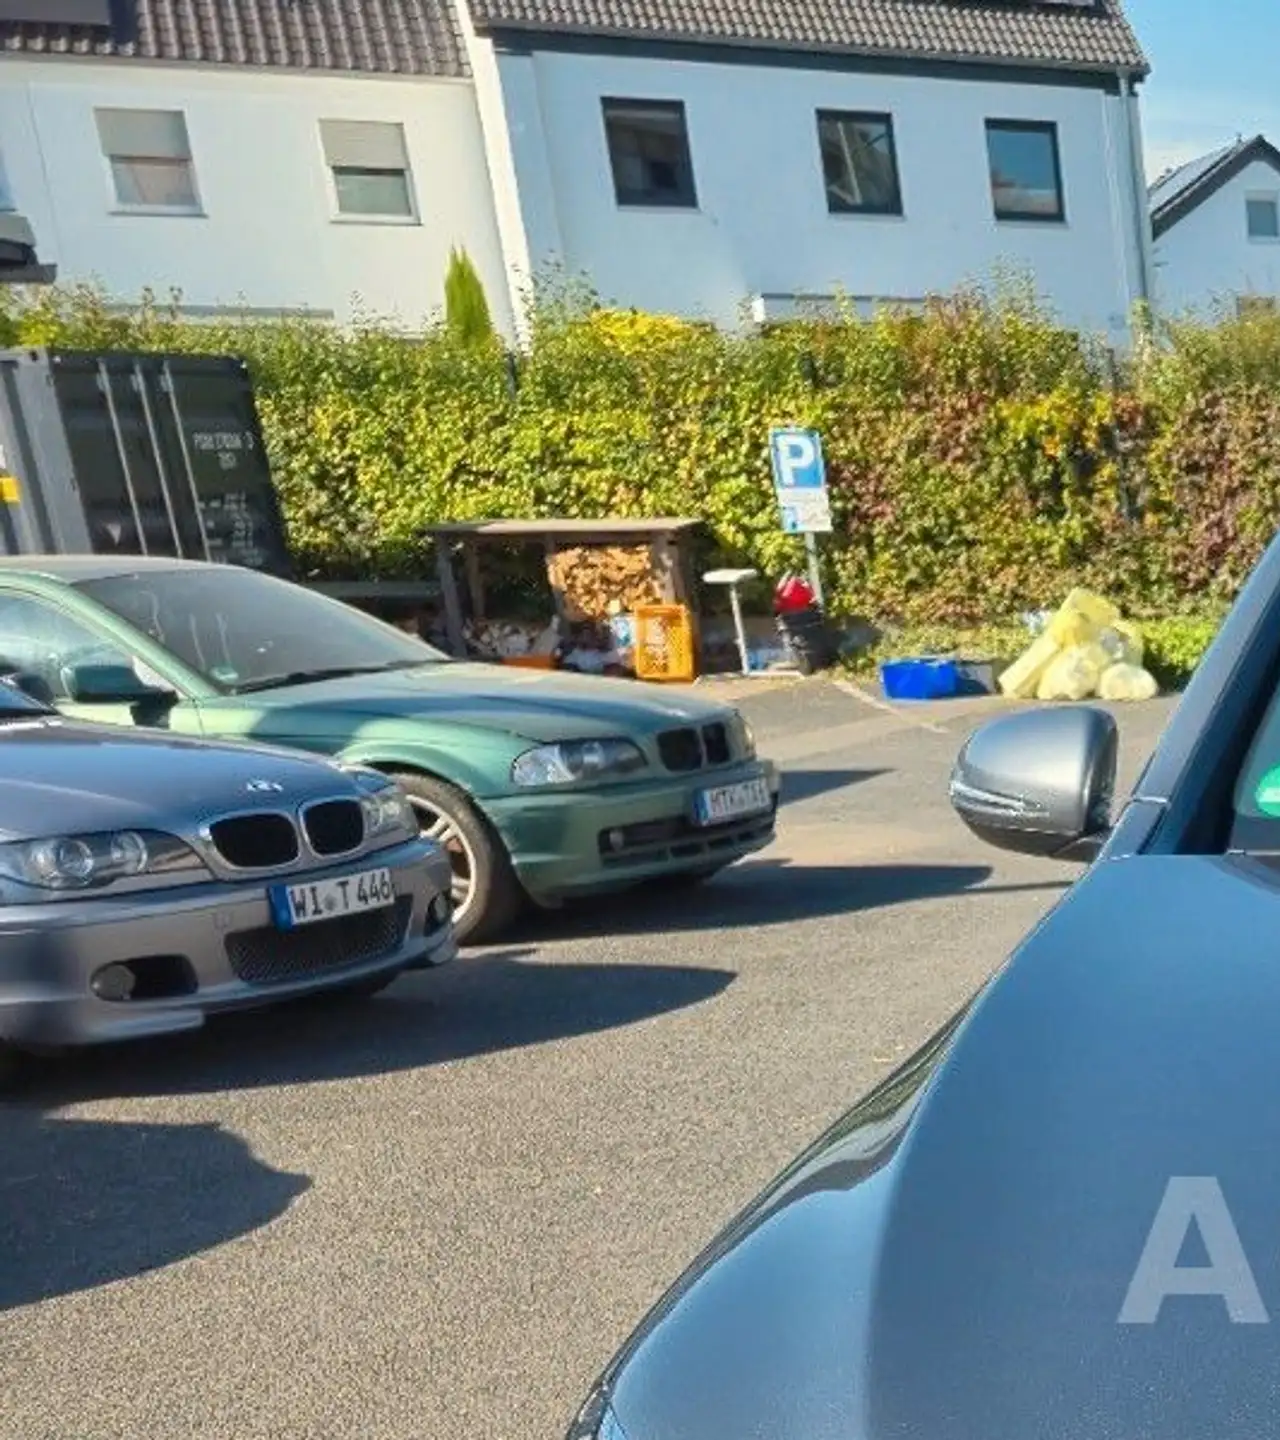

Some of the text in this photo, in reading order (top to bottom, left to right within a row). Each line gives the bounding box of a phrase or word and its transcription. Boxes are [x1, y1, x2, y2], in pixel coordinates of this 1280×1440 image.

[776, 434, 815, 487] P
[290, 871, 391, 917] WI T 446
